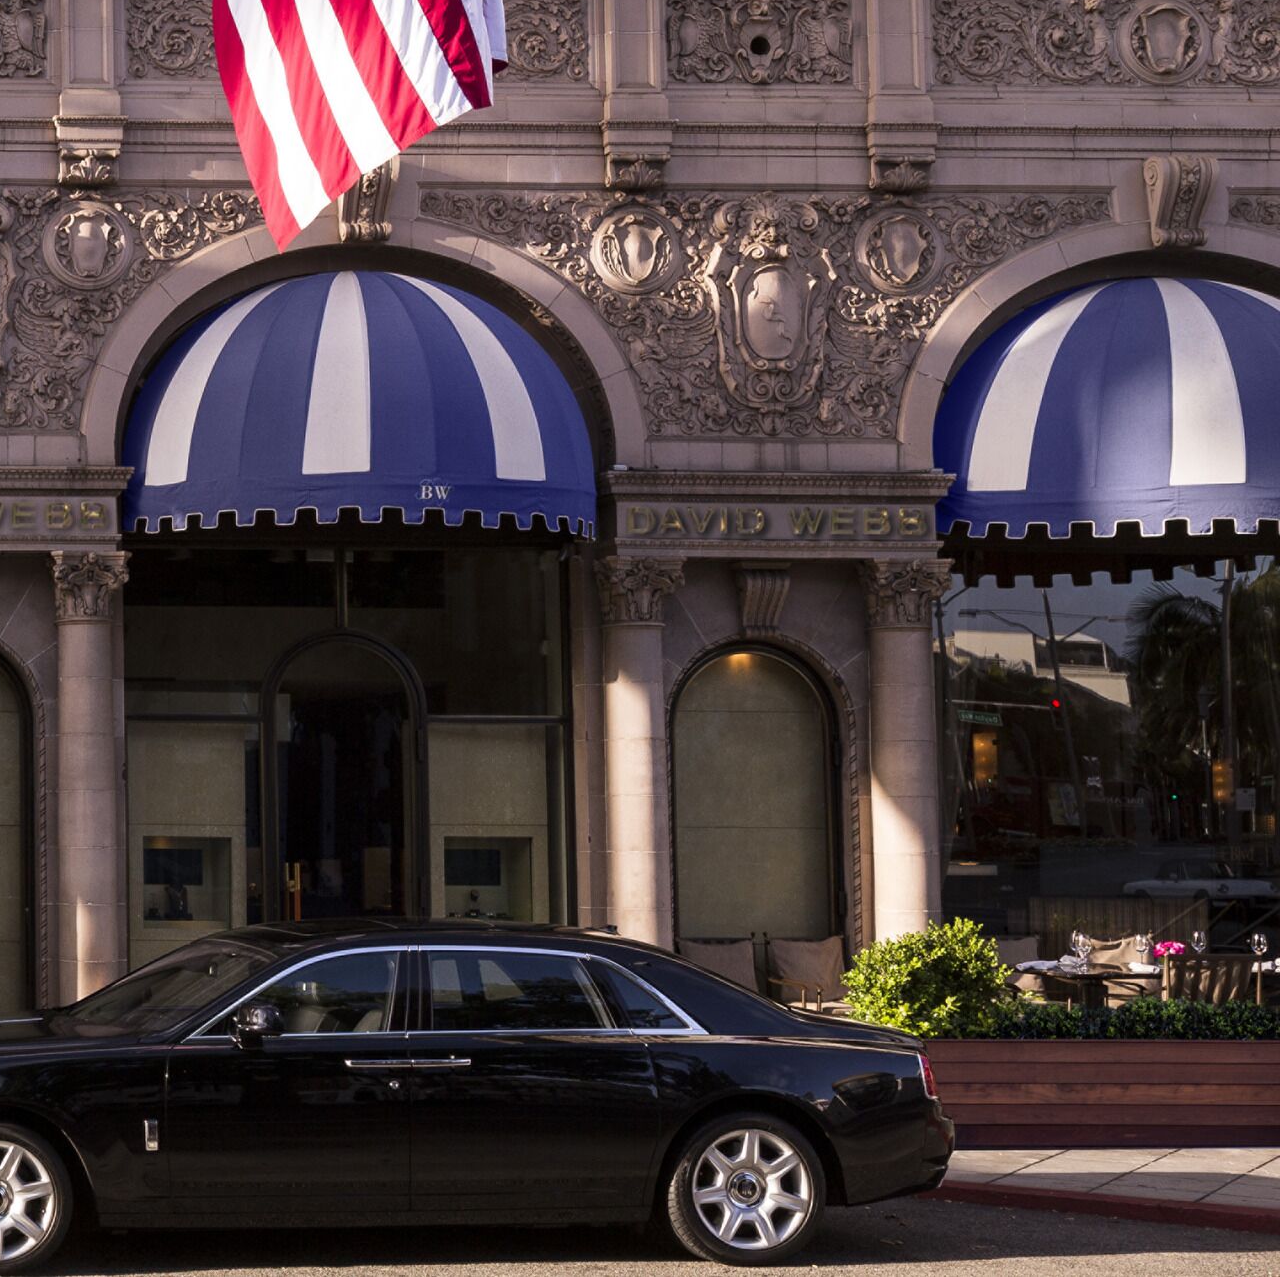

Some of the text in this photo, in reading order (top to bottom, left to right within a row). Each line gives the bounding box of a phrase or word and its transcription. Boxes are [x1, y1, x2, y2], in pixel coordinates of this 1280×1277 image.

[421, 485, 450, 500] BW
[625, 505, 929, 536] DAVID WEBB
